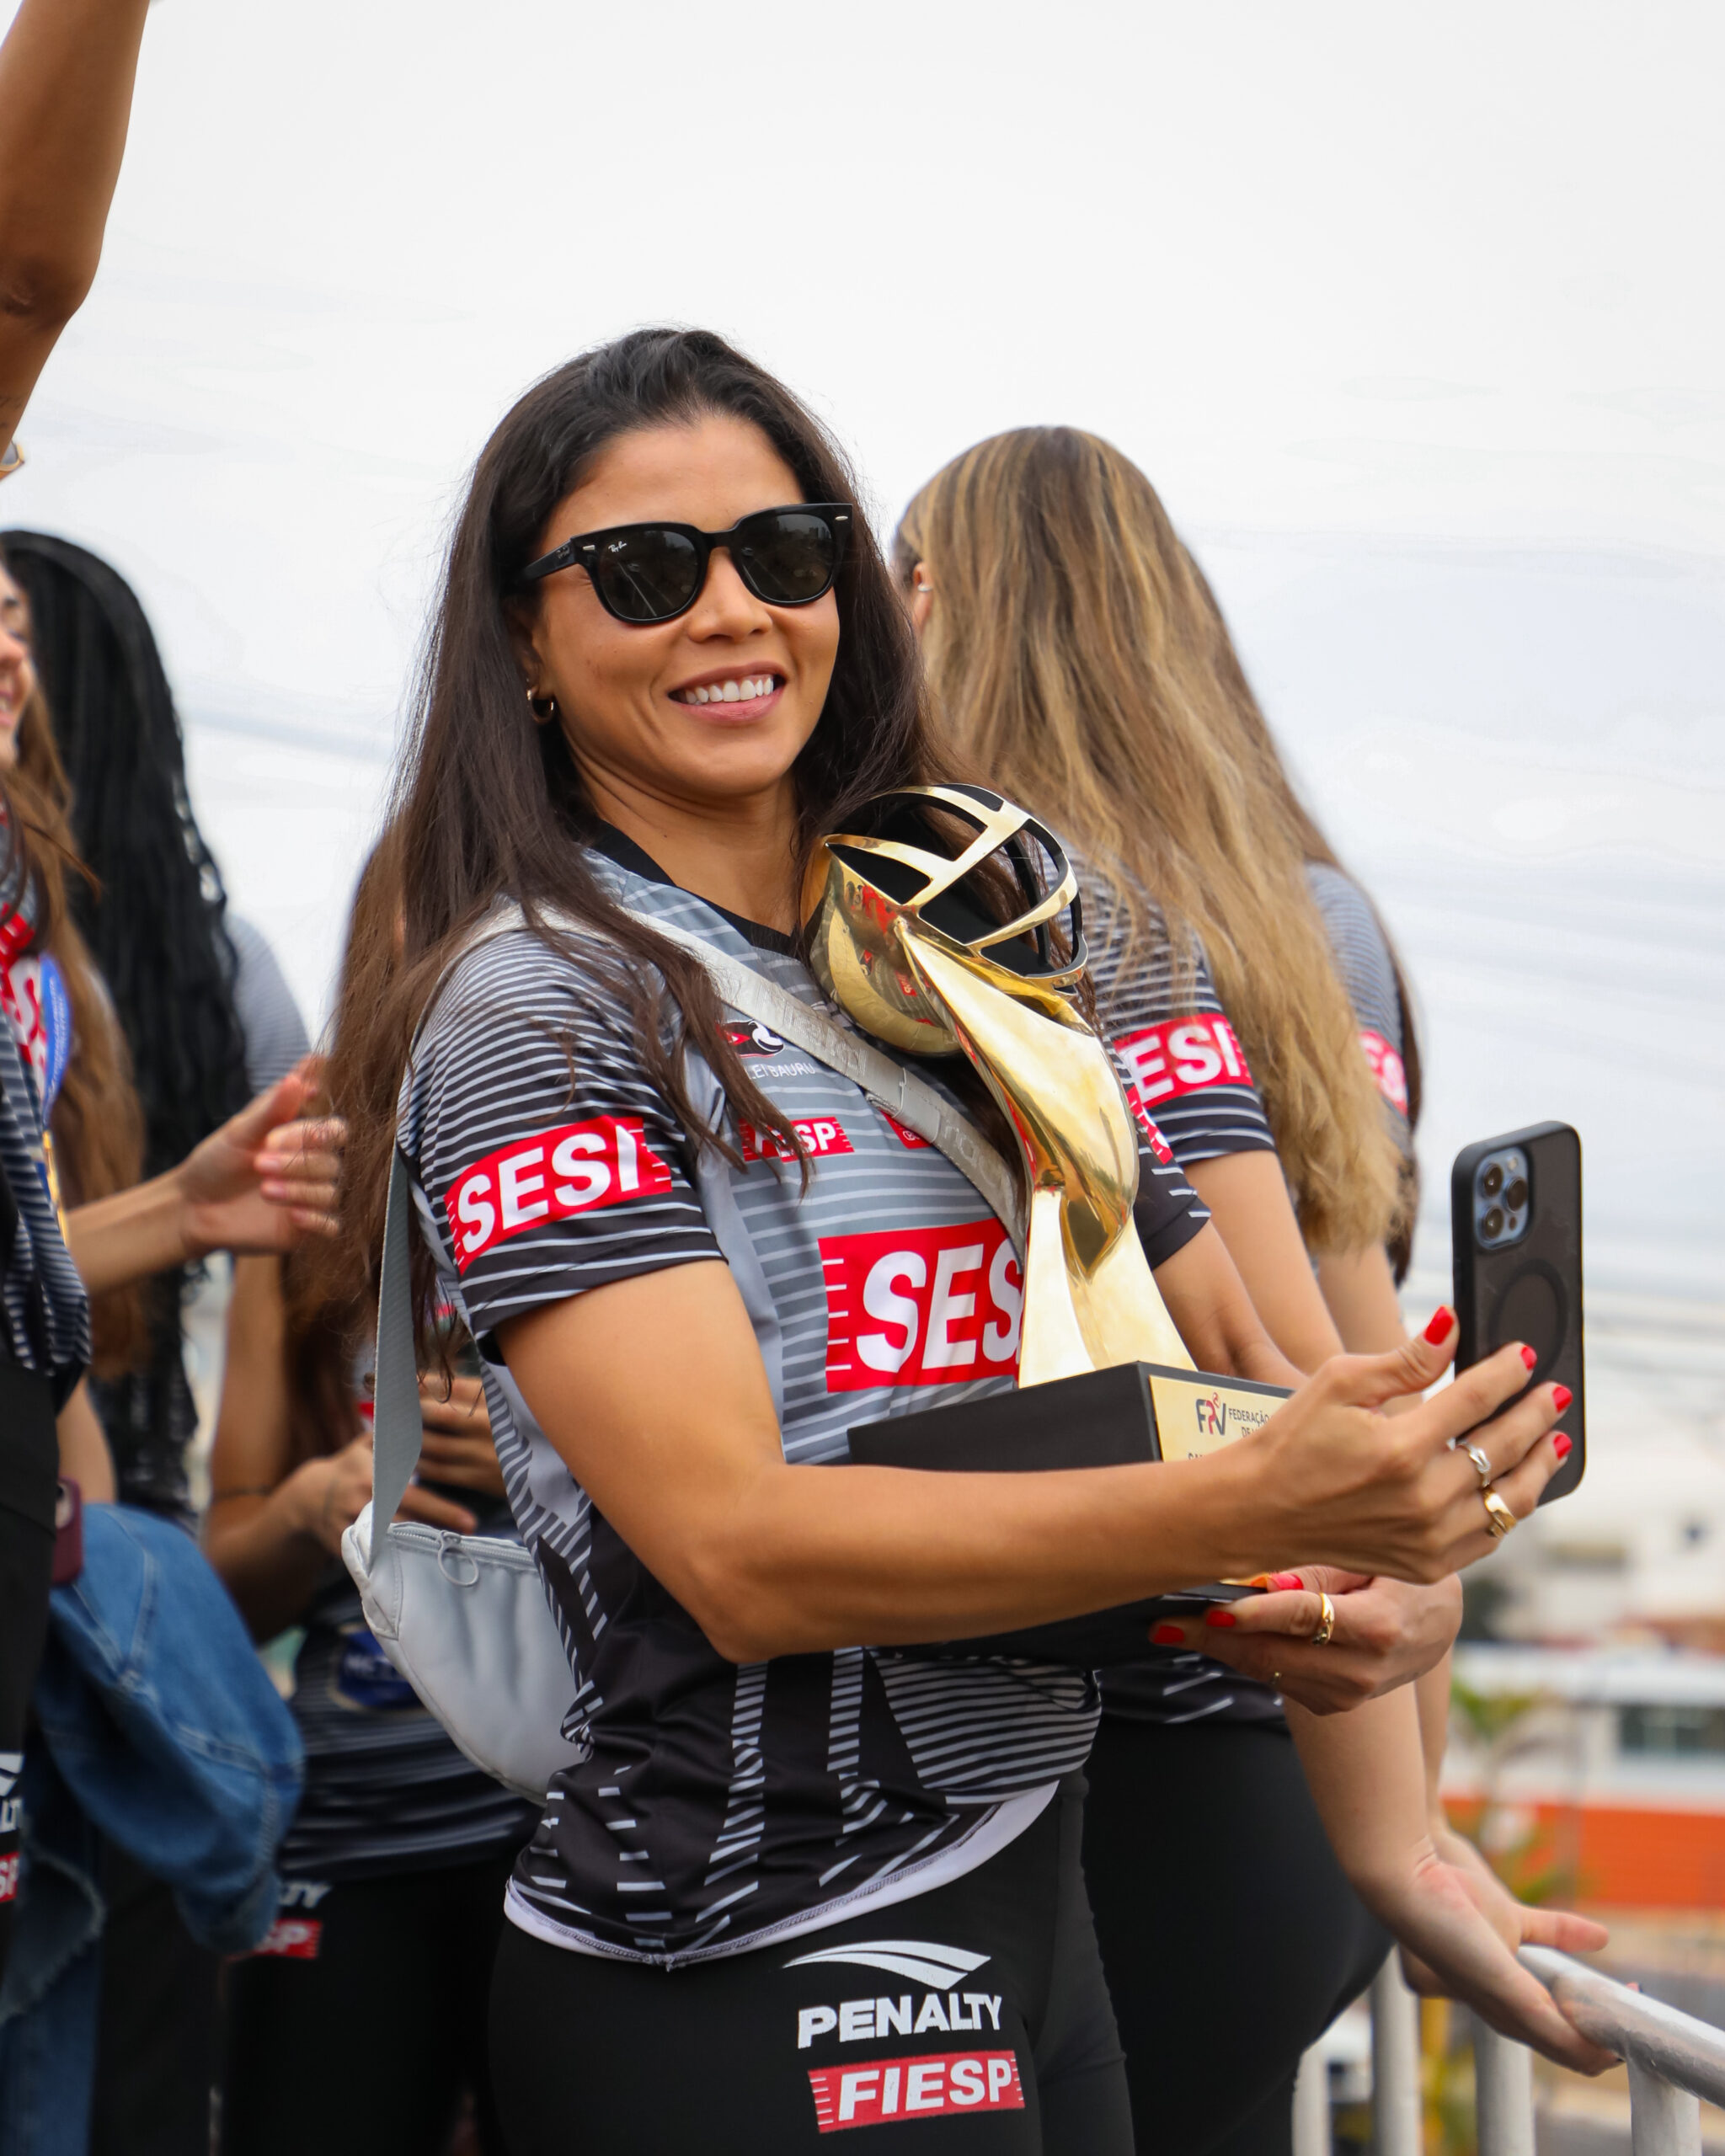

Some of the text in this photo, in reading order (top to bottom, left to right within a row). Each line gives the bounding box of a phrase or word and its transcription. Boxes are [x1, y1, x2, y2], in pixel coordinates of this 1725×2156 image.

[766, 1062, 816, 1078] BAURU
[1119, 1021, 1242, 1104] ESI
[457, 1124, 639, 1253] SESI
[856, 1237, 1023, 1374] SES
[797, 1991, 1002, 2049] PENALTY
[838, 2058, 1012, 2121] FIESP
